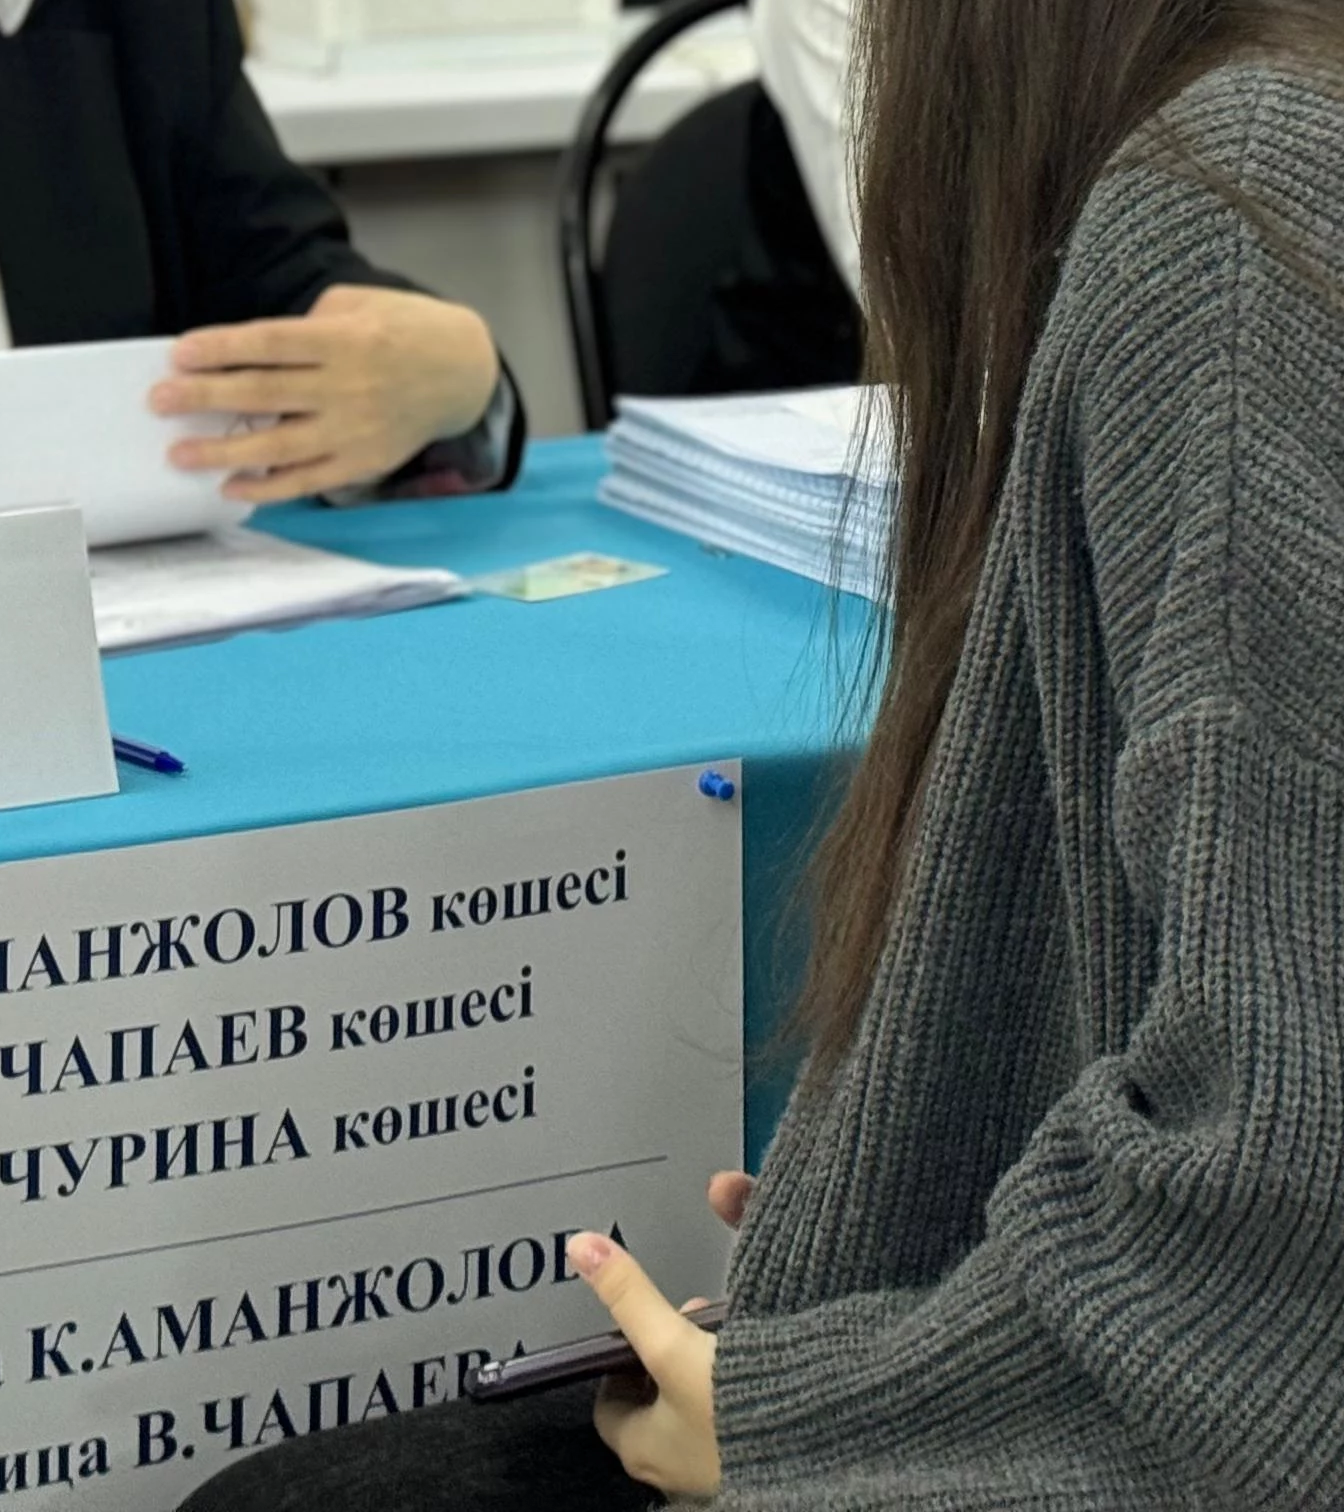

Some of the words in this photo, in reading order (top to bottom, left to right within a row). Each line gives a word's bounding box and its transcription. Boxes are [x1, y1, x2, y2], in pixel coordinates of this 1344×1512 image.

[429, 848, 630, 936] көшесі
[328, 965, 535, 1054] көшесі
[331, 1064, 538, 1155] көшесі
